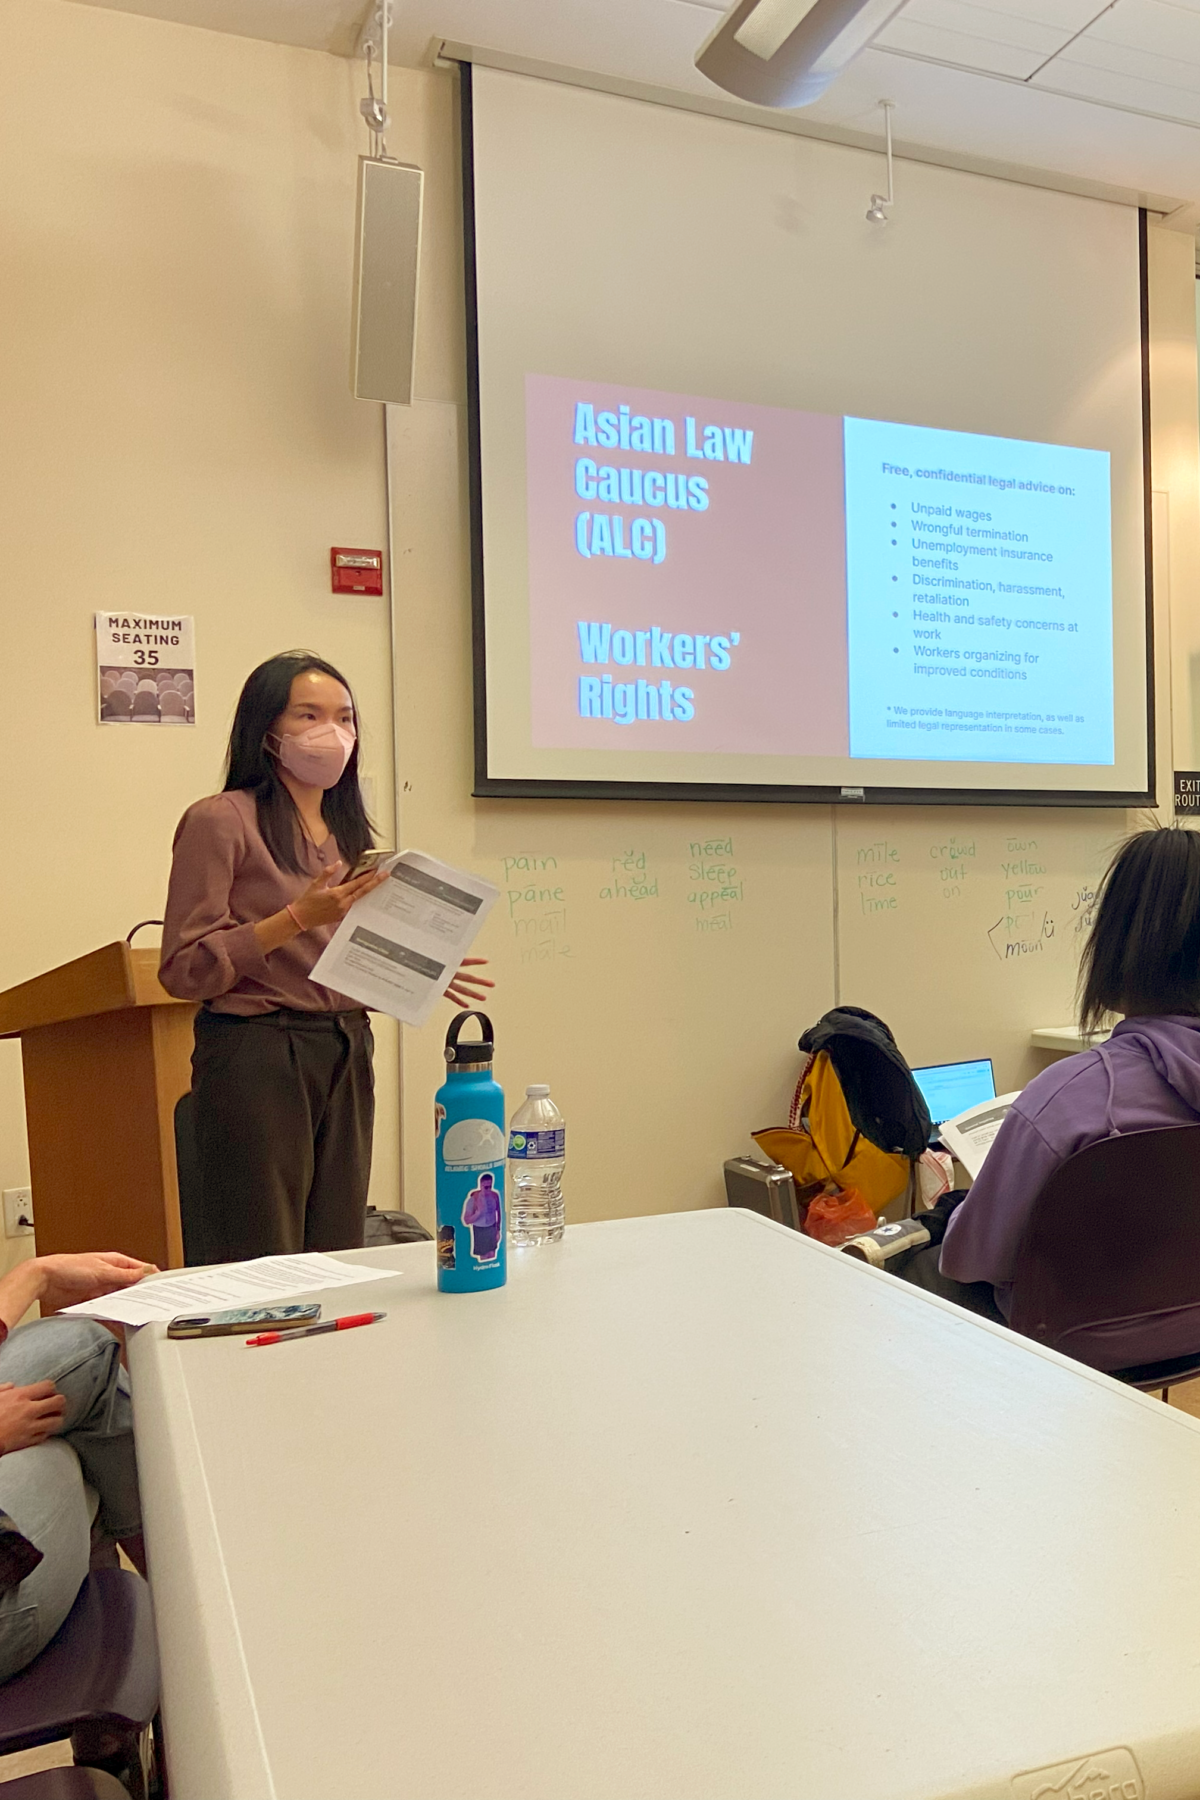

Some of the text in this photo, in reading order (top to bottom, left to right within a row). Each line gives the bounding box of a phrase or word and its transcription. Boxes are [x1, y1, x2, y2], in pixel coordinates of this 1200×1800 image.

[574, 402, 754, 464] Asian Law
[575, 457, 710, 511] Caucus
[882, 462, 1076, 496] Free, confidential legal advice on:
[911, 502, 992, 522] Unpaid wages
[575, 511, 666, 564] (ALC)
[911, 520, 1028, 543] Wrongful termination
[912, 538, 1054, 562] Unemployment insurance
[912, 556, 959, 571] benefits
[912, 573, 1065, 599] Discrimination, harassment,
[913, 592, 969, 607] retaliation
[108, 617, 182, 631] MAXIMUM
[913, 609, 1078, 633] Health and safety concerns at
[112, 633, 180, 645] SEATING
[913, 629, 942, 640] work
[133, 649, 159, 666] 35
[913, 645, 1040, 665] Workers organizing for
[913, 663, 1027, 680] improved conditions
[578, 674, 695, 724] Rights
[893, 706, 1085, 723] We provide language interpretation, as well as
[886, 719, 1064, 735] limited legal representation in some cases.
[1180, 779, 1200, 792] EXIT
